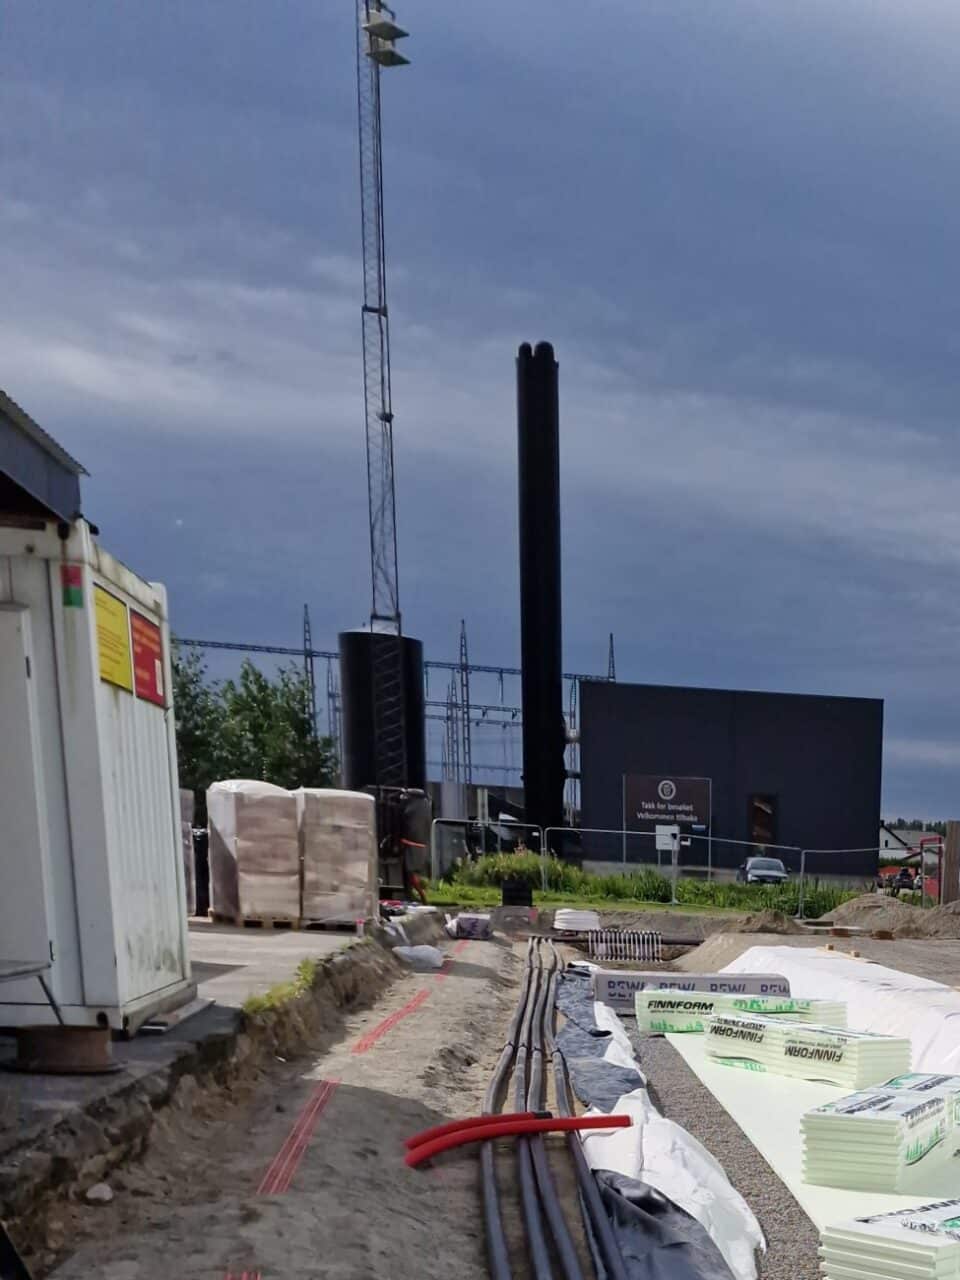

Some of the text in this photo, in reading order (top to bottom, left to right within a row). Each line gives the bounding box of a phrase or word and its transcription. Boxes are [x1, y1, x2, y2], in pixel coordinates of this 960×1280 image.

[648, 1000, 714, 1010] FINNFORM
[709, 1024, 765, 1043] FINNFORM
[784, 1045, 844, 1063] FINNFORM
